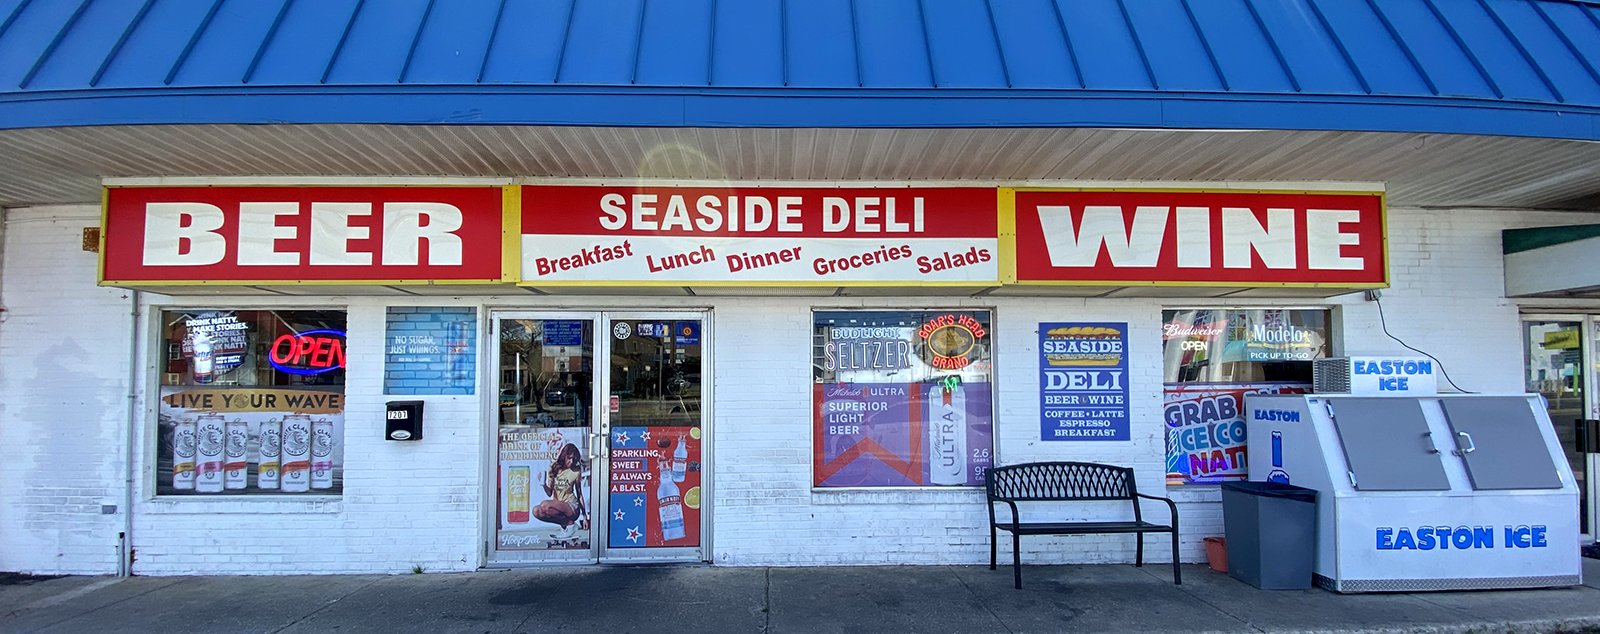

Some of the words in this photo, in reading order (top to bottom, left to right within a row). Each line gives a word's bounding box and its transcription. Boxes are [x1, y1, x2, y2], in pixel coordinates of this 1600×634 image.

[599, 192, 803, 232] SEASIDE
[822, 196, 925, 233] DELI
[142, 201, 463, 266] BEER
[1036, 205, 1366, 271] WINE
[535, 239, 633, 276] Breakfast
[646, 244, 716, 274] Lunch
[726, 244, 802, 274] Dinner
[812, 242, 913, 276] Groceries
[916, 245, 992, 275] Salads
[215, 322, 248, 331] STORIES.
[919, 314, 955, 339] BOAR'S
[958, 314, 986, 338] HEAD
[1163, 323, 1224, 336] Budweiser
[395, 335, 407, 344] NO
[1253, 324, 1303, 343] Modelo
[270, 334, 348, 369] OPEN
[389, 345, 407, 354] JUST
[1043, 340, 1123, 353] SEASIDE
[1181, 341, 1207, 351] OPEN
[825, 341, 910, 371] SELTZER
[932, 356, 969, 369] BRAND
[1353, 360, 1433, 375] EASTON
[1044, 371, 1123, 390] DELI
[1378, 377, 1409, 391] ICE
[870, 387, 905, 396] ULTRA
[169, 393, 213, 408] LIVE
[284, 393, 340, 408] WAVE
[1044, 395, 1079, 404] BEER
[1088, 395, 1124, 404] WINE
[829, 401, 889, 412] SUPERIOR
[1164, 396, 1237, 427] GRAB
[829, 413, 865, 423] LIGHT
[1044, 410, 1085, 418] COFFEE
[1092, 410, 1125, 418] LATTE
[1254, 408, 1300, 423] EASTON
[502, 431, 519, 441] THE
[829, 425, 860, 435] BEER
[1054, 429, 1116, 437] BREAKFAST
[942, 411, 955, 467] ULTRA
[501, 442, 528, 451] DRINK
[973, 448, 989, 458] 2.6
[612, 461, 640, 469] SWEET
[612, 472, 619, 481] &
[619, 472, 653, 481] ALWAYS
[611, 484, 618, 492] A
[619, 484, 647, 492] BLAST.
[501, 534, 524, 547] Hoop
[1376, 524, 1494, 550] EASTON
[1504, 524, 1548, 549] ICE
